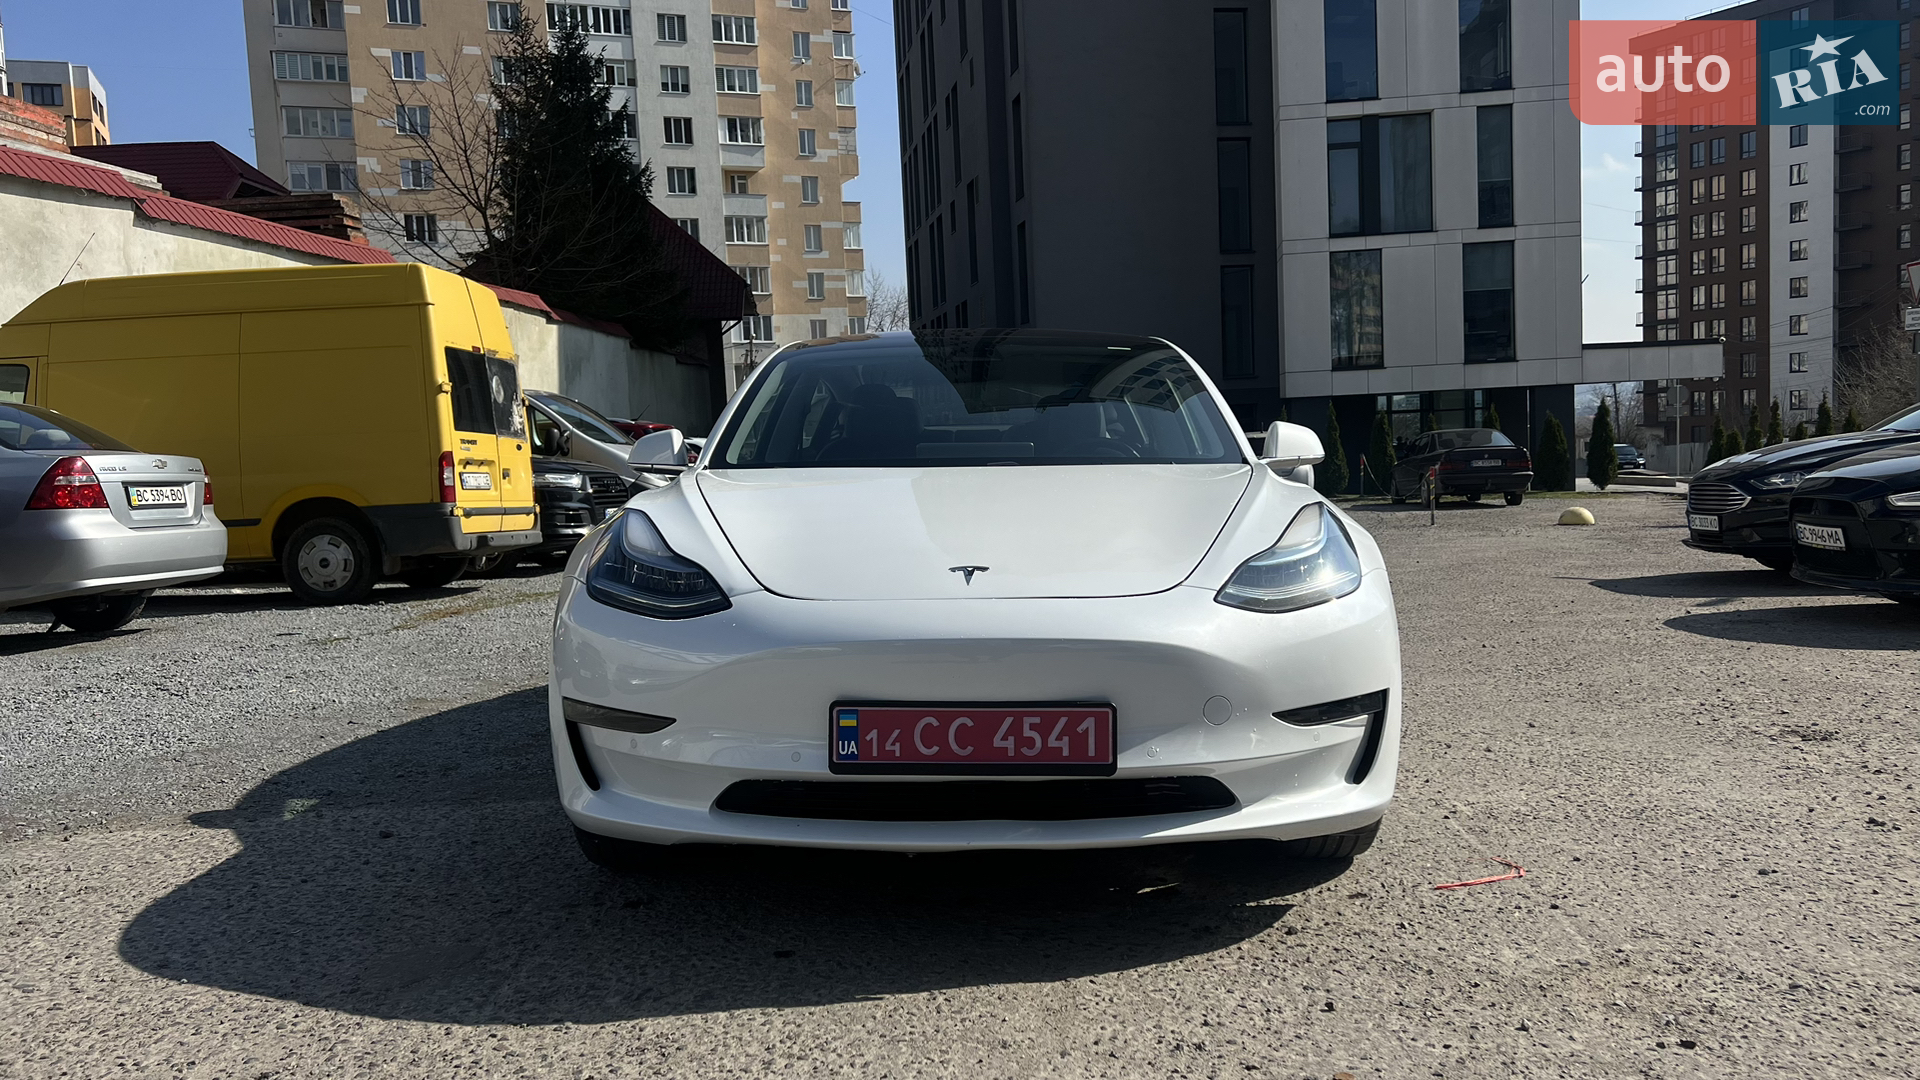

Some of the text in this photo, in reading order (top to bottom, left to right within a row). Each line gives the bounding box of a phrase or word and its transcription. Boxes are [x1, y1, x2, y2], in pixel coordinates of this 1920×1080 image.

[136, 488, 183, 502] BC 5394 BO
[1691, 516, 1698, 527] BC
[1709, 517, 1718, 529] KO
[1799, 525, 1842, 545] BC 9946 MA
[864, 716, 1096, 757] 14 CC 4541
[838, 740, 859, 755] UA
